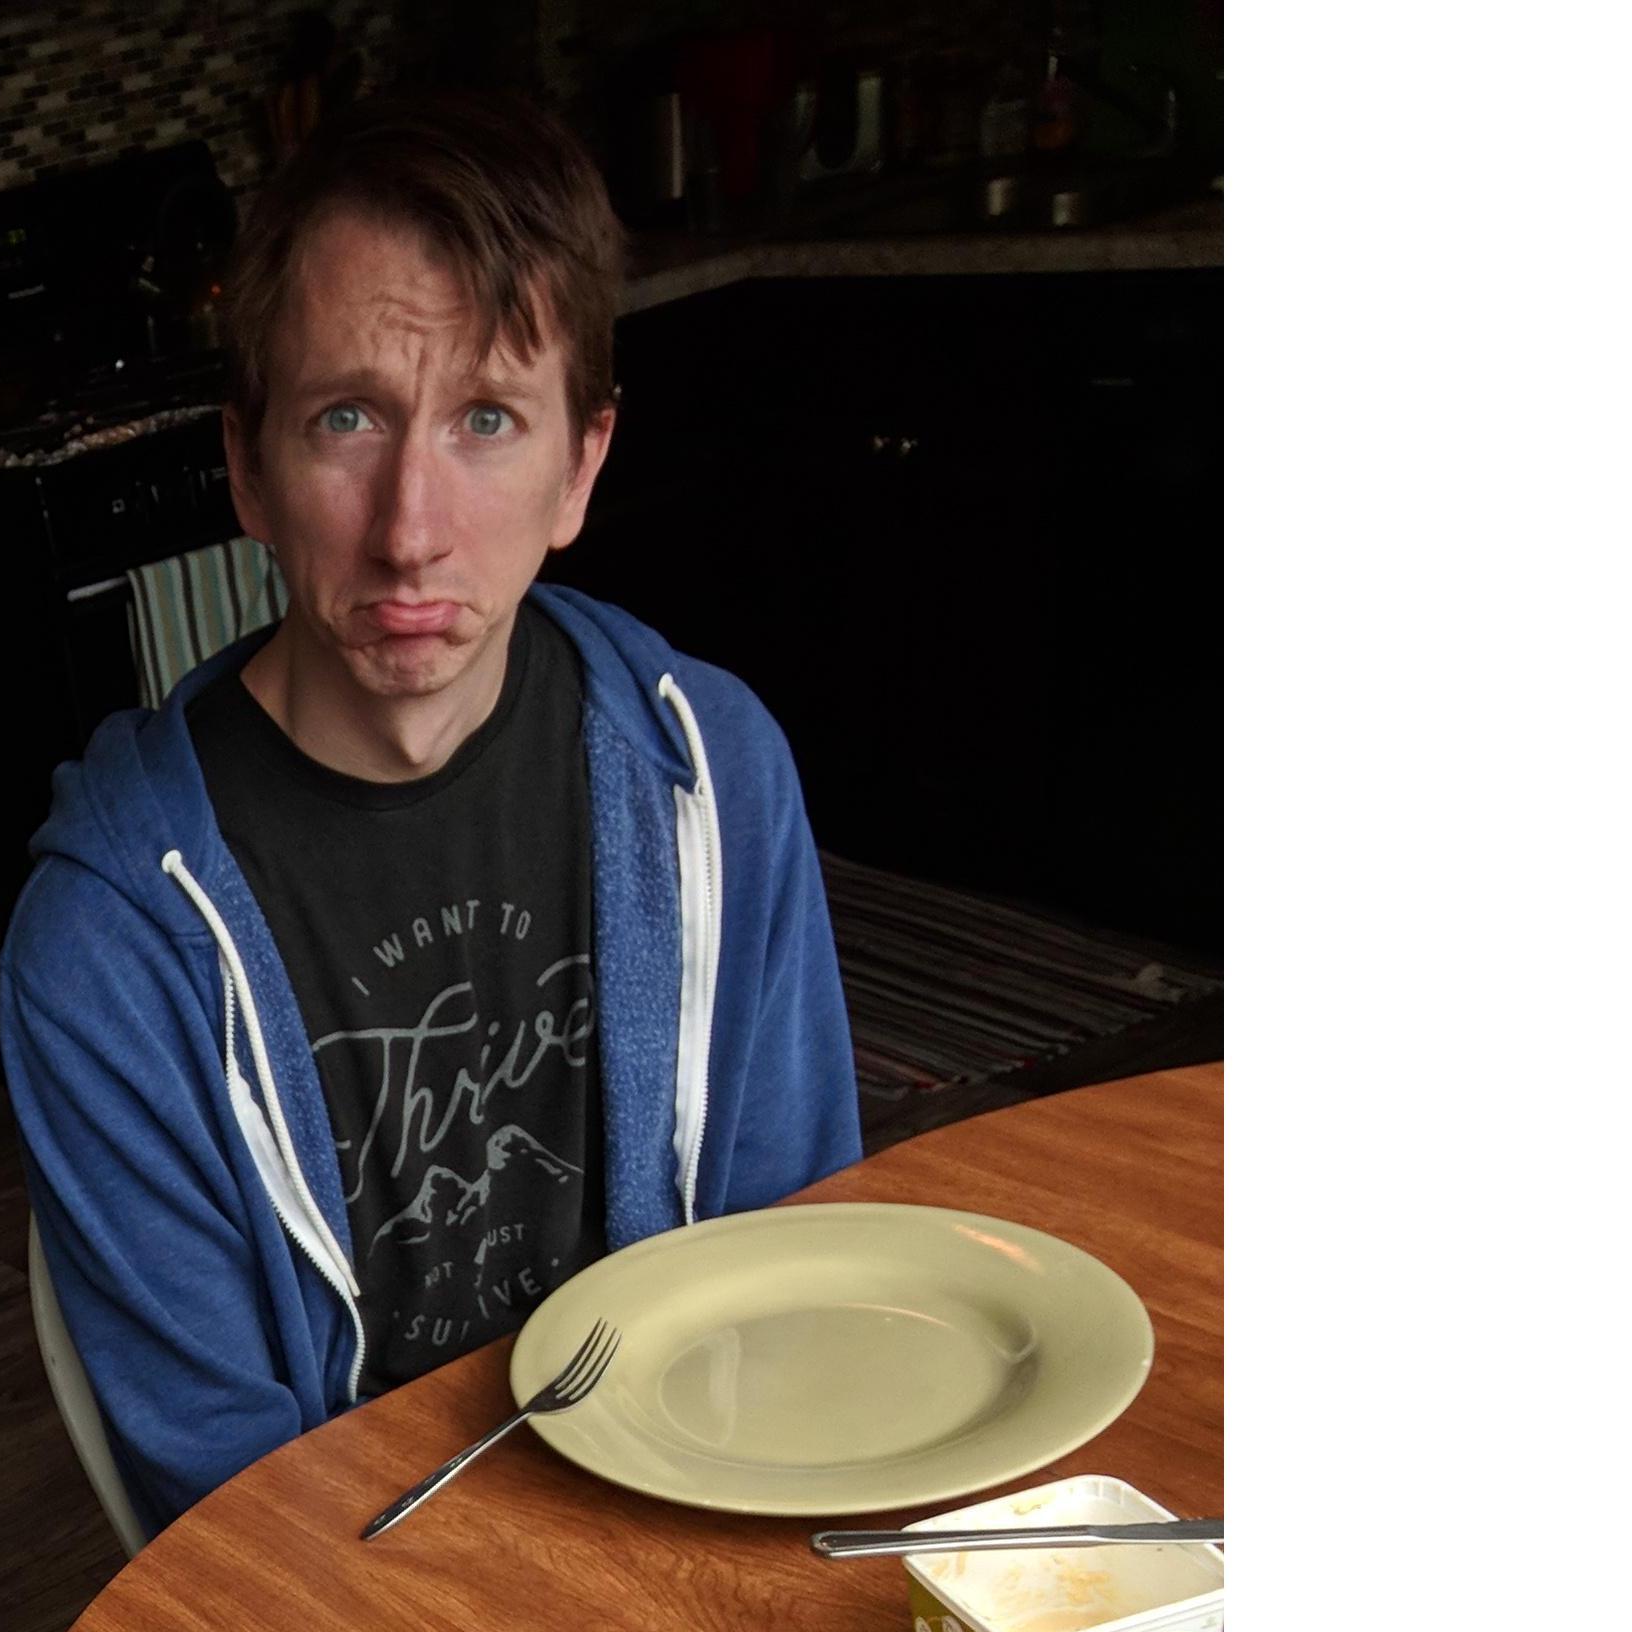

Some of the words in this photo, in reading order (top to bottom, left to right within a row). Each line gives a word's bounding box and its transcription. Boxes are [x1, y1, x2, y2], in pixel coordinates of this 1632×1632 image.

[351, 976, 370, 996] I
[373, 900, 479, 967] WANT
[501, 902, 530, 940] TO
[313, 953, 593, 1203] Thrive
[486, 1223, 525, 1247] UST
